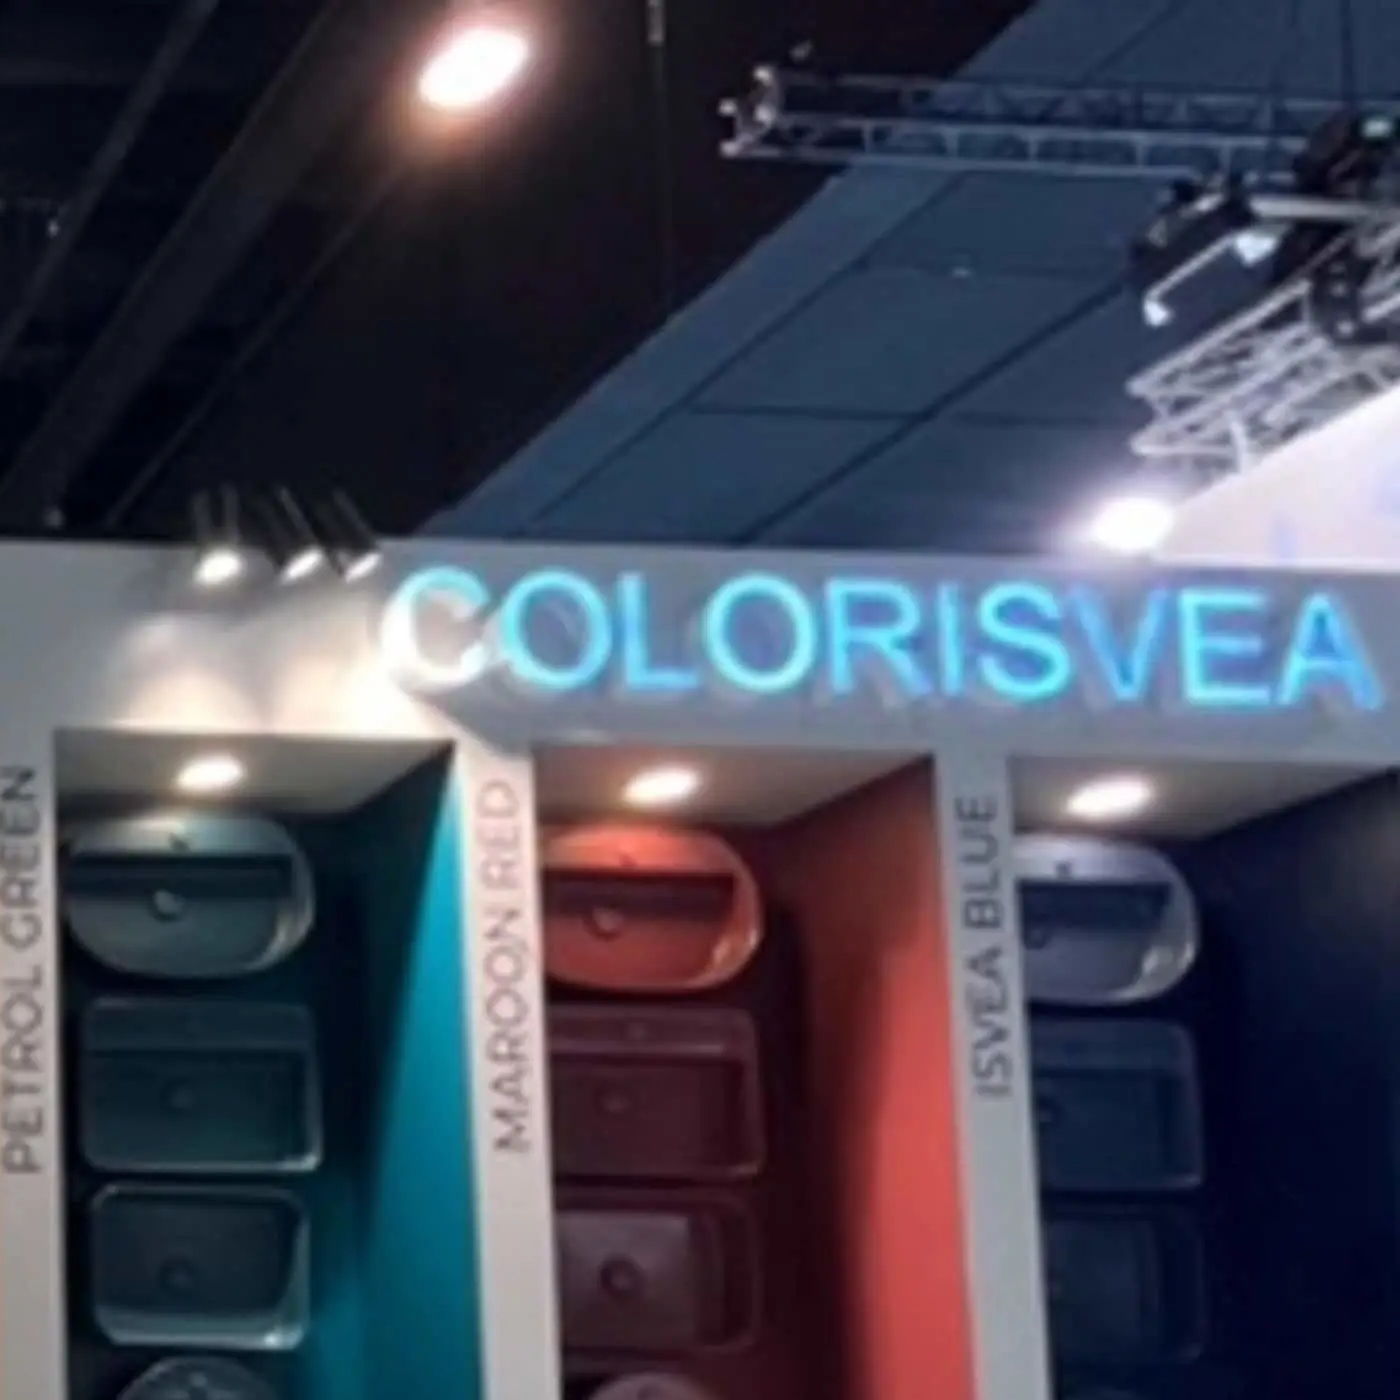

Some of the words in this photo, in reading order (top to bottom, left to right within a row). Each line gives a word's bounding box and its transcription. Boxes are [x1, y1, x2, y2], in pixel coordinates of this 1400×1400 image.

[378, 566, 1382, 710] COLORISVEA
[476, 778, 521, 890] RED
[955, 796, 1003, 930] BLUE
[0, 964, 46, 1174] PETROL
[483, 906, 532, 1154] MAROON
[967, 945, 1013, 1096] ISVEA
